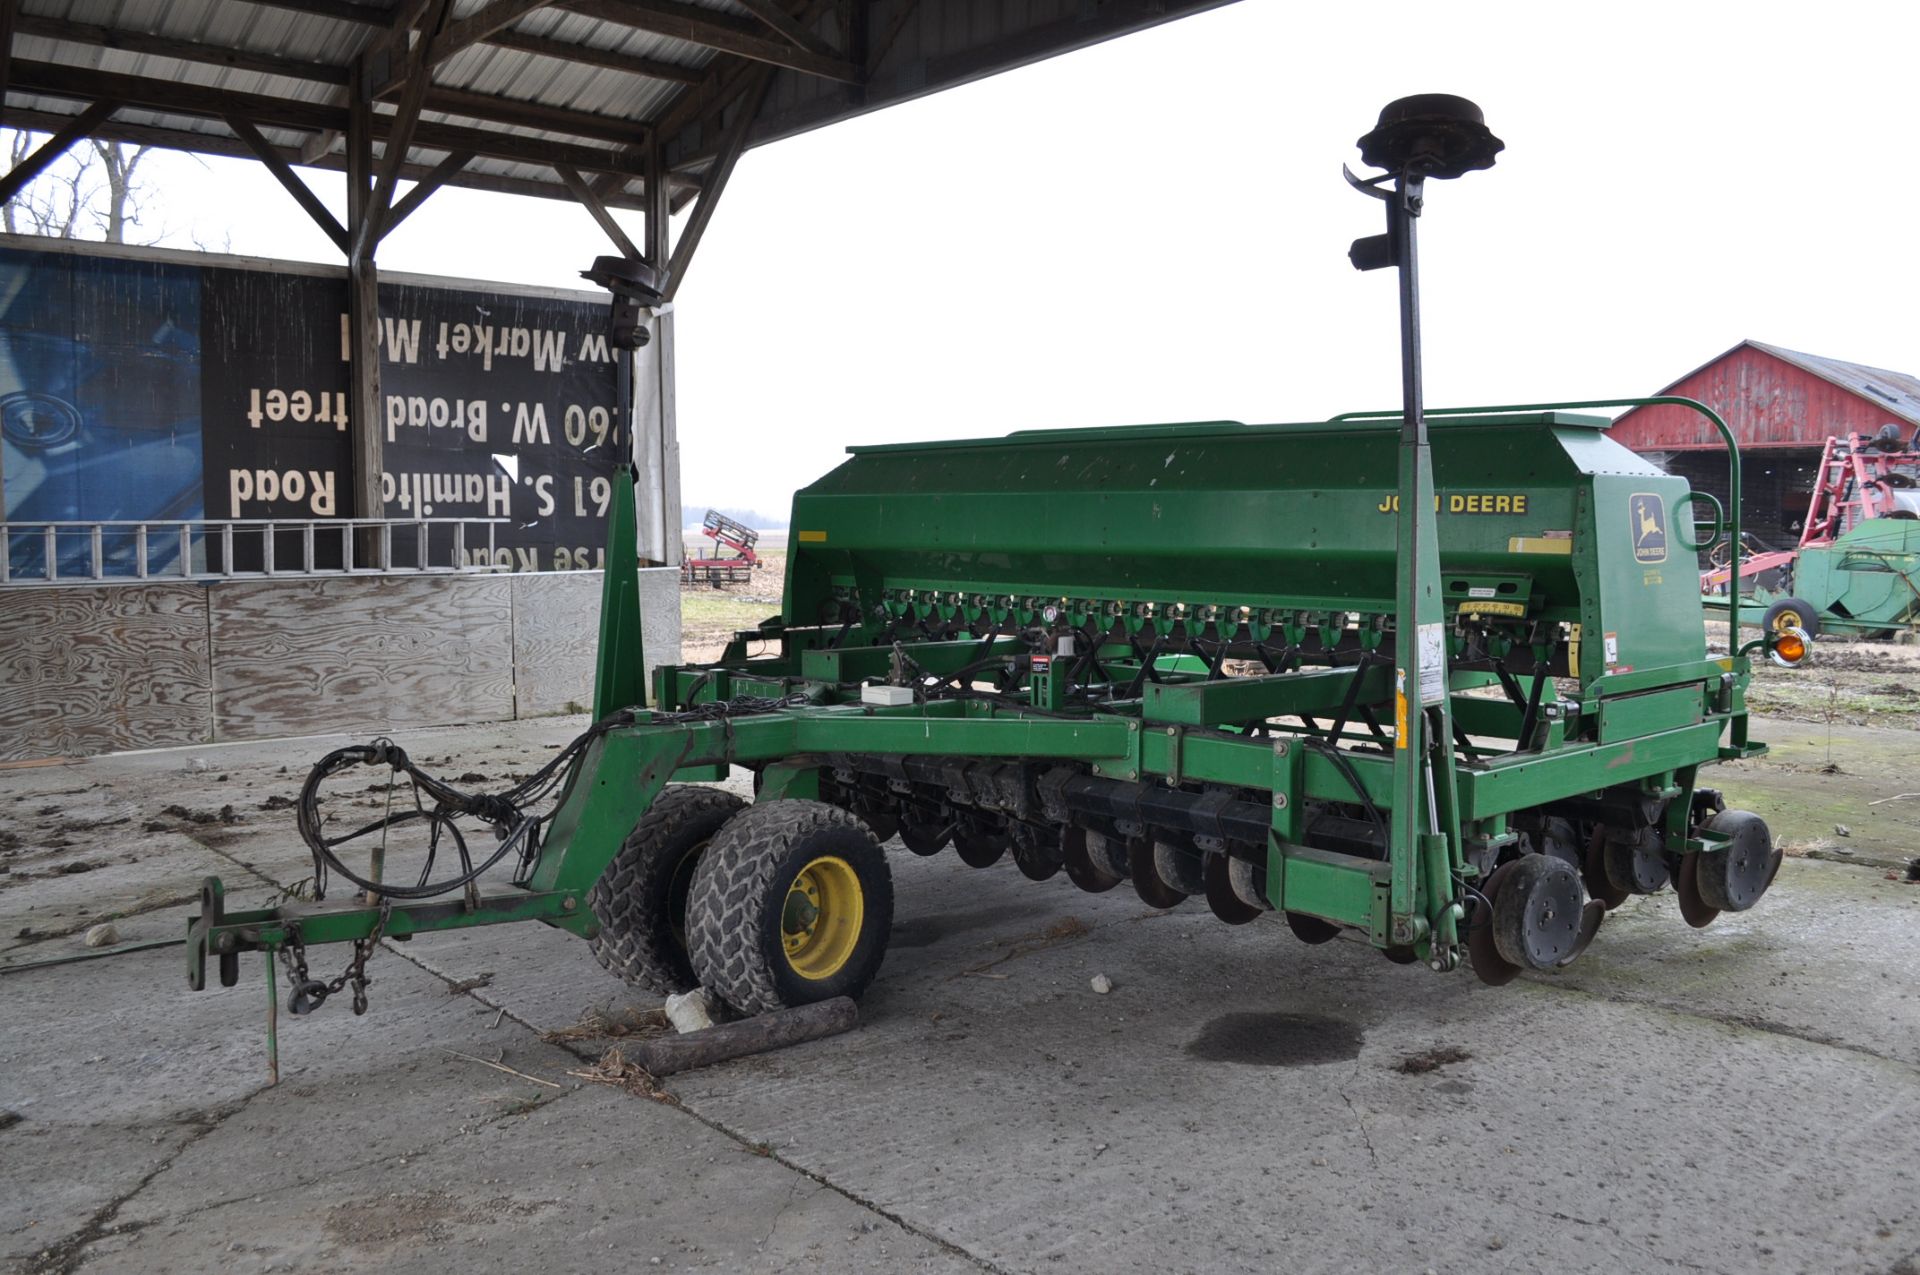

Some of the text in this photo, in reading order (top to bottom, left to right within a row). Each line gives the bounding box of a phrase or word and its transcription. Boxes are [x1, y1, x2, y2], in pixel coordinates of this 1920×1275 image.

[340, 313, 618, 373] w Market Ml
[247, 388, 618, 446] 60 W. Broad treet
[229, 469, 612, 518] 61 S. Hamilto Road
[1450, 495, 1526, 513] DEERE
[553, 546, 605, 572] rse
[1636, 547, 1665, 557] JOHN DEERE
